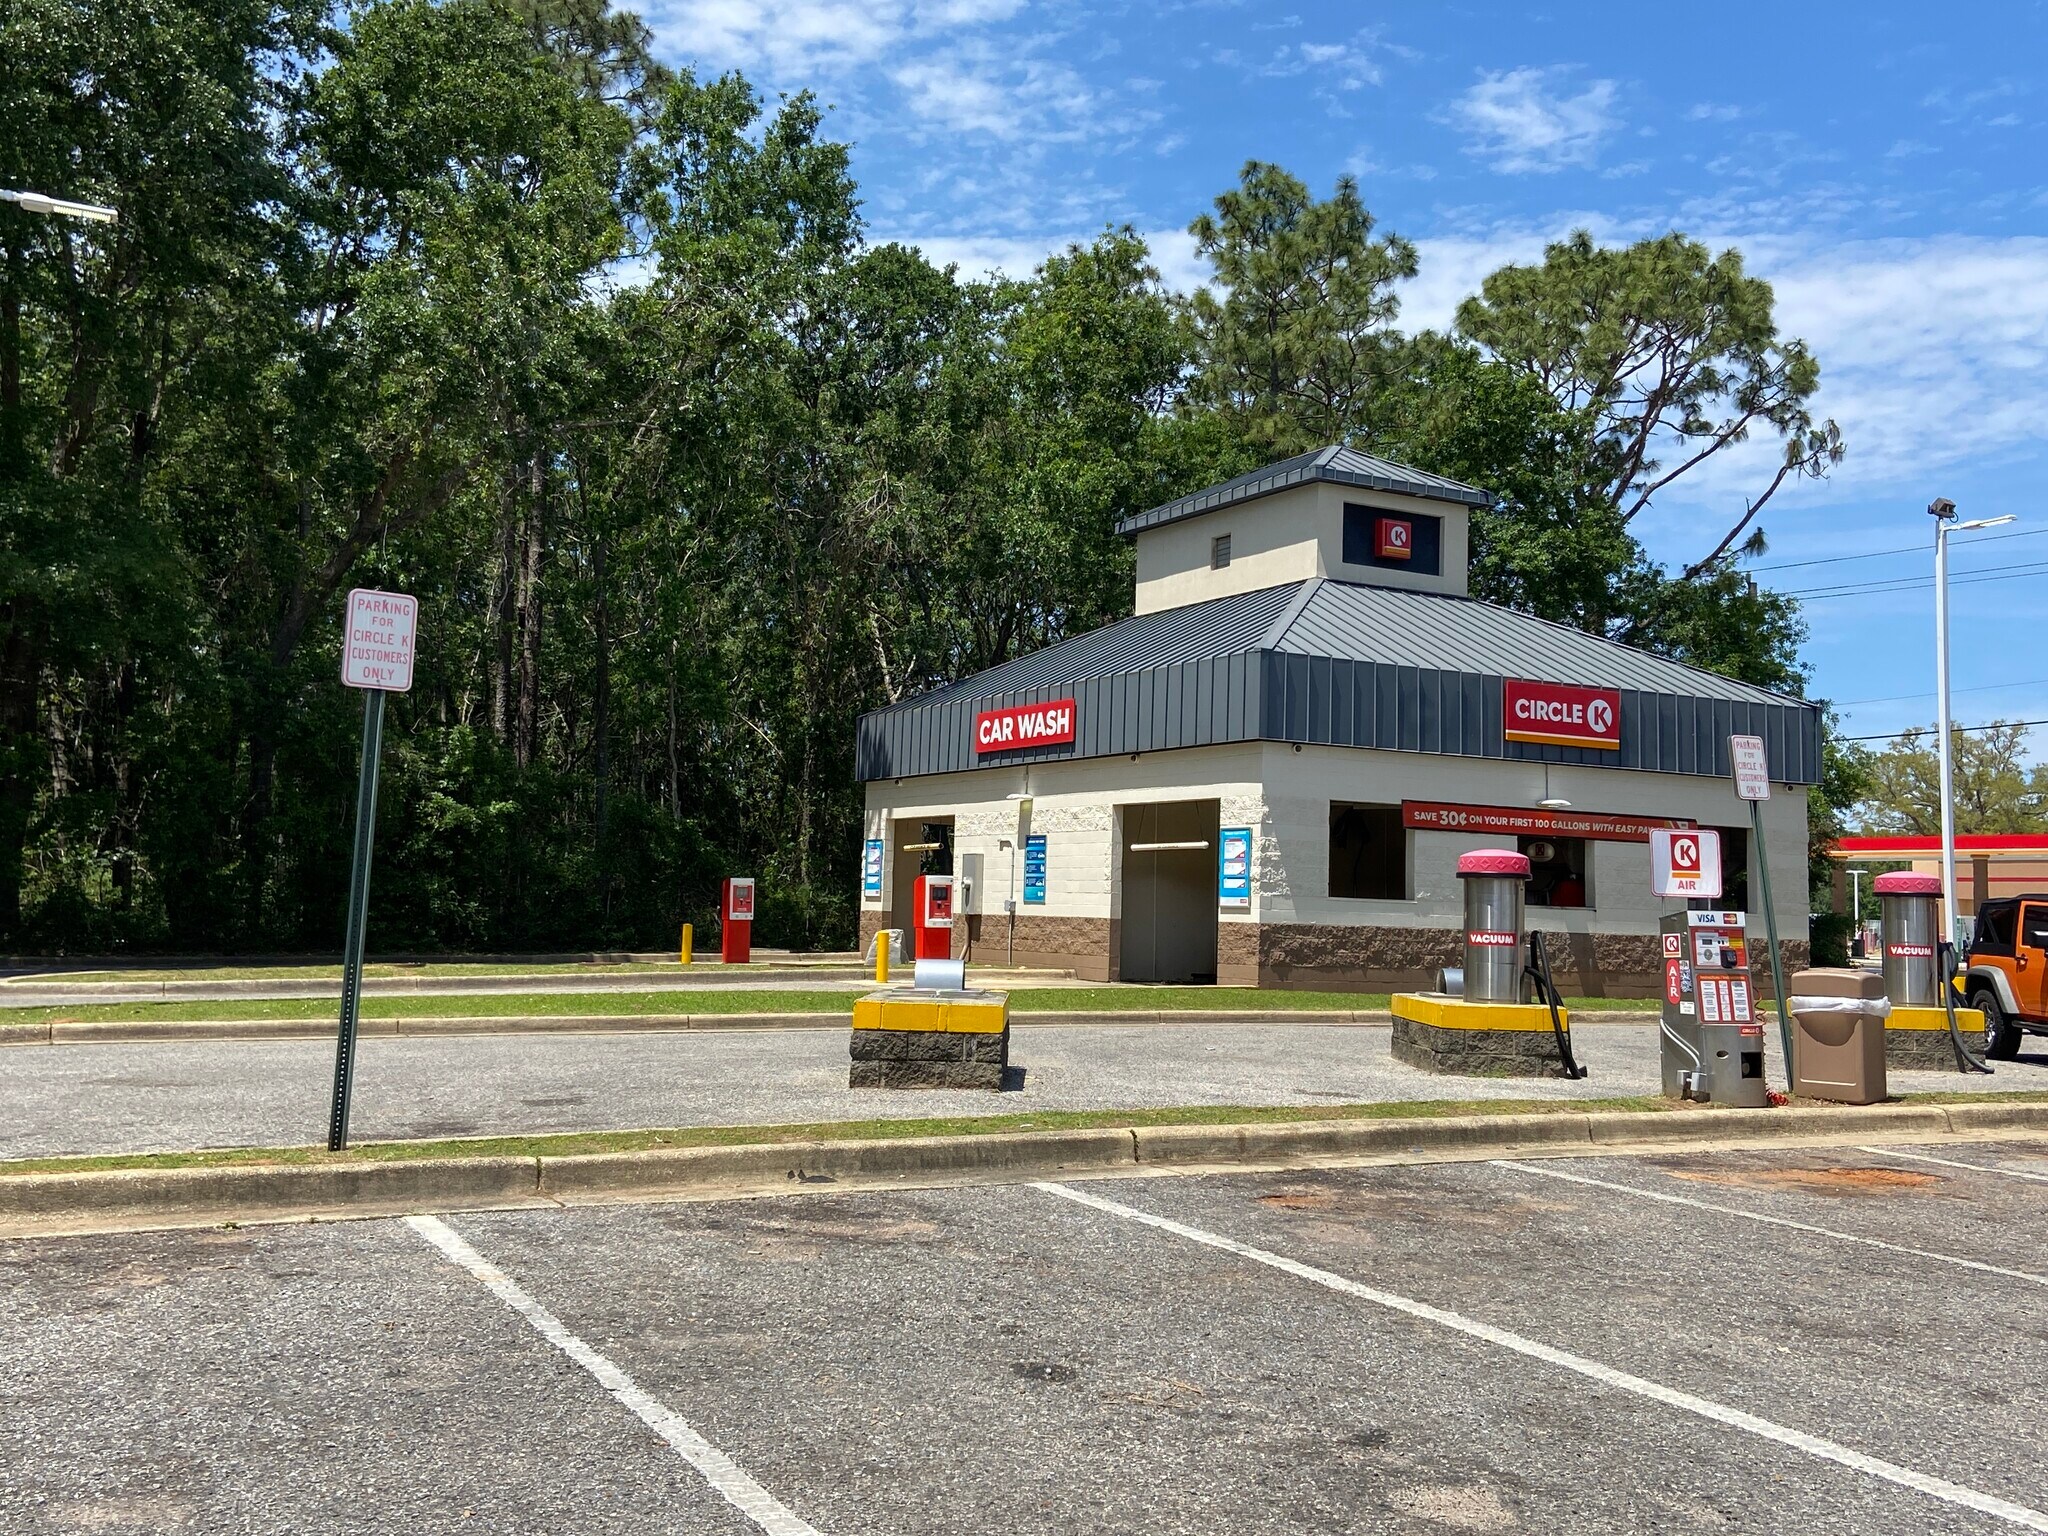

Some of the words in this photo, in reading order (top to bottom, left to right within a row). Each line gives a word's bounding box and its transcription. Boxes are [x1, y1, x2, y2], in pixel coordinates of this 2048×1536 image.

[357, 599, 410, 616] PARKING
[372, 616, 394, 627] FOR
[353, 629, 395, 646] CIRCLE
[401, 635, 409, 647] K
[352, 647, 409, 665] CUSTOMERS
[363, 666, 395, 681] ONLY
[1515, 698, 1583, 724] CIRCLE
[1589, 701, 1612, 732] K
[980, 716, 1014, 744] CAR
[1017, 708, 1070, 740] WASH
[1736, 741, 1761, 750] PARKING
[1738, 762, 1757, 771] CIRCLE
[1746, 785, 1762, 794] ONLY
[1414, 811, 1438, 821] SAVE
[1439, 810, 1467, 826] 30¢
[1469, 815, 1483, 824] ON
[1484, 816, 1508, 826] YOUR
[1509, 817, 1533, 827] FIRST
[1534, 819, 1550, 829] 100
[1551, 820, 1591, 831] GALLONS
[1592, 823, 1615, 832] WITH
[1615, 825, 1637, 834] EASY
[1676, 841, 1696, 866] K
[1677, 880, 1697, 890] AIR
[1696, 914, 1716, 923] VISA
[1470, 934, 1514, 944] VACUUM
[1890, 946, 1932, 956] VACUUM
[1669, 965, 1679, 997] AIR
